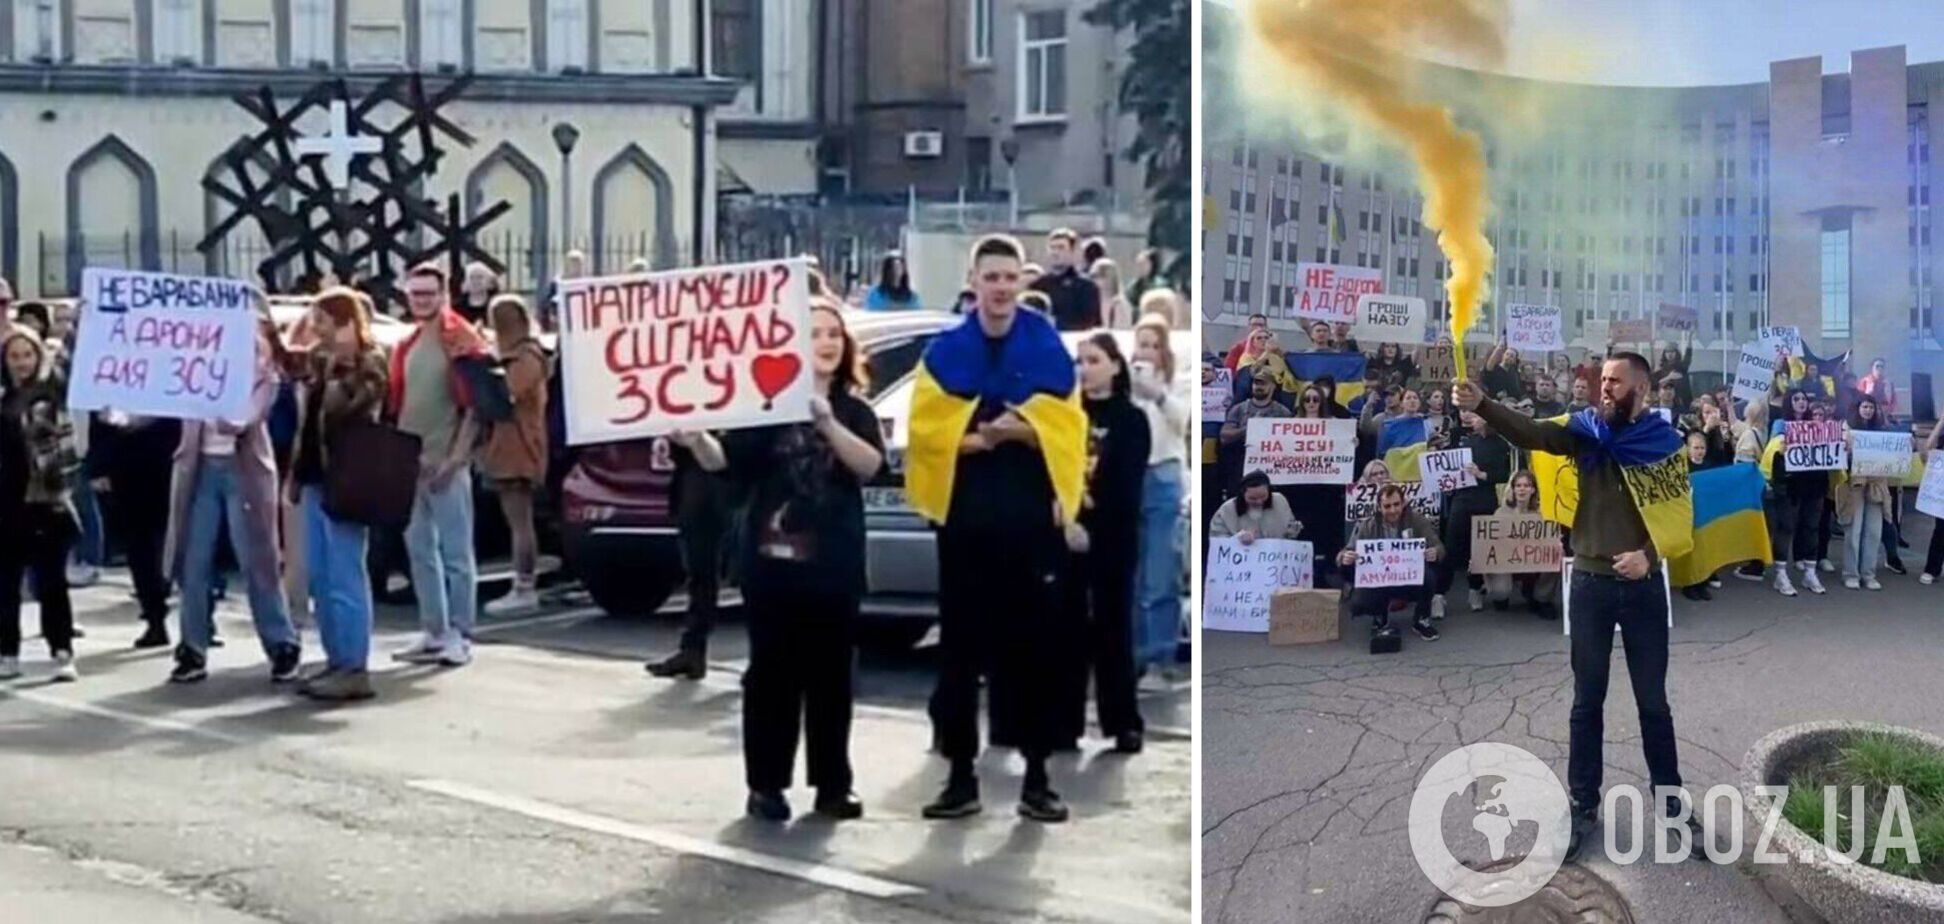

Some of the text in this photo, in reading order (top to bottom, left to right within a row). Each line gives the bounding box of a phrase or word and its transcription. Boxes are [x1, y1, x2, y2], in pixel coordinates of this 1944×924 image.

[1306, 268, 1334, 289] НЕ
[1301, 290, 1358, 317] А ДРО
[1368, 302, 1409, 315] ГРОШІ
[110, 317, 224, 355] А ДРОНИ
[605, 310, 795, 374] СИГНАЛЬ
[94, 356, 228, 401] ДЛЯ ЗСУ
[610, 362, 736, 425] ЗСУ
[1271, 420, 1327, 436] ГРОШІ
[1260, 440, 1284, 452] НА
[1356, 483, 1378, 502] 27
[1477, 520, 1560, 540] НЕ ДОРОГИ
[1364, 541, 1429, 554] НЕ МЕТРО
[1486, 544, 1560, 565] А ДРОНИ
[1264, 565, 1302, 587] ЗСУ
[1234, 591, 1253, 604] НЕ
